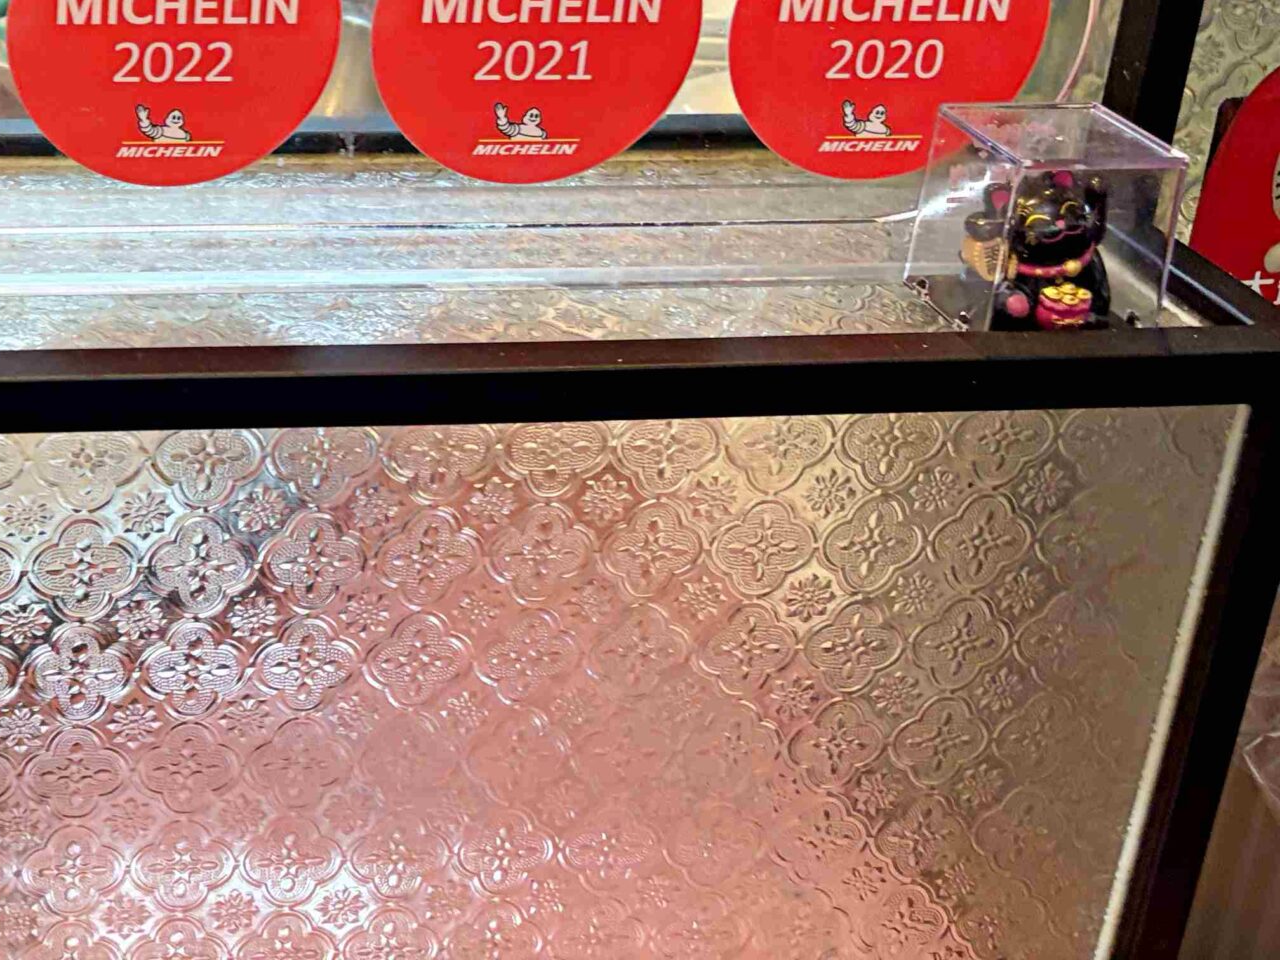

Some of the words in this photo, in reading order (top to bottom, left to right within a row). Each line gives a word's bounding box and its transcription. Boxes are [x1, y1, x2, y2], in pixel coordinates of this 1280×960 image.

[112, 40, 234, 84] 2022
[474, 39, 593, 82] 2021
[825, 38, 945, 80] 2020
[116, 145, 224, 158] MICHELIN
[472, 143, 580, 156] MICHELIN
[818, 140, 920, 152] MICHELIN
